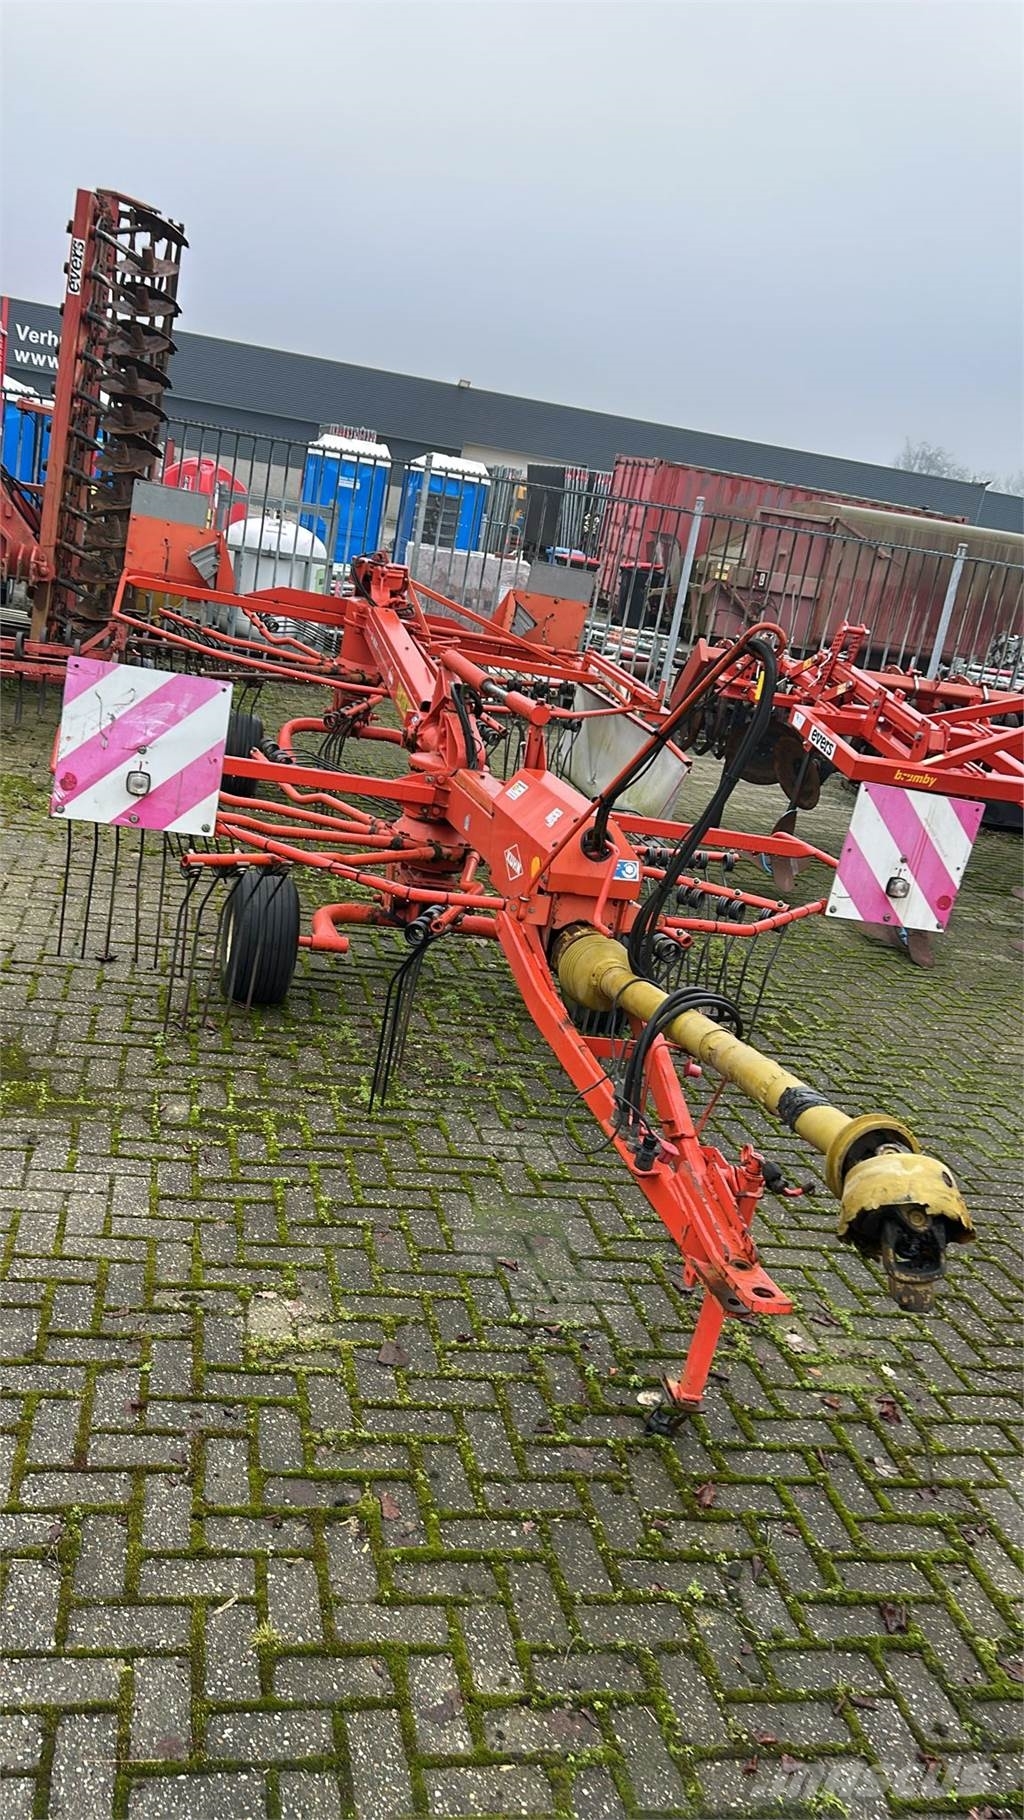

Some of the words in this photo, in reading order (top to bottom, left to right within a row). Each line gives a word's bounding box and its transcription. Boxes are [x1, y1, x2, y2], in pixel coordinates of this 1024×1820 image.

[68, 240, 85, 293] evers
[15, 323, 62, 348] Verh
[811, 729, 834, 756] evers
